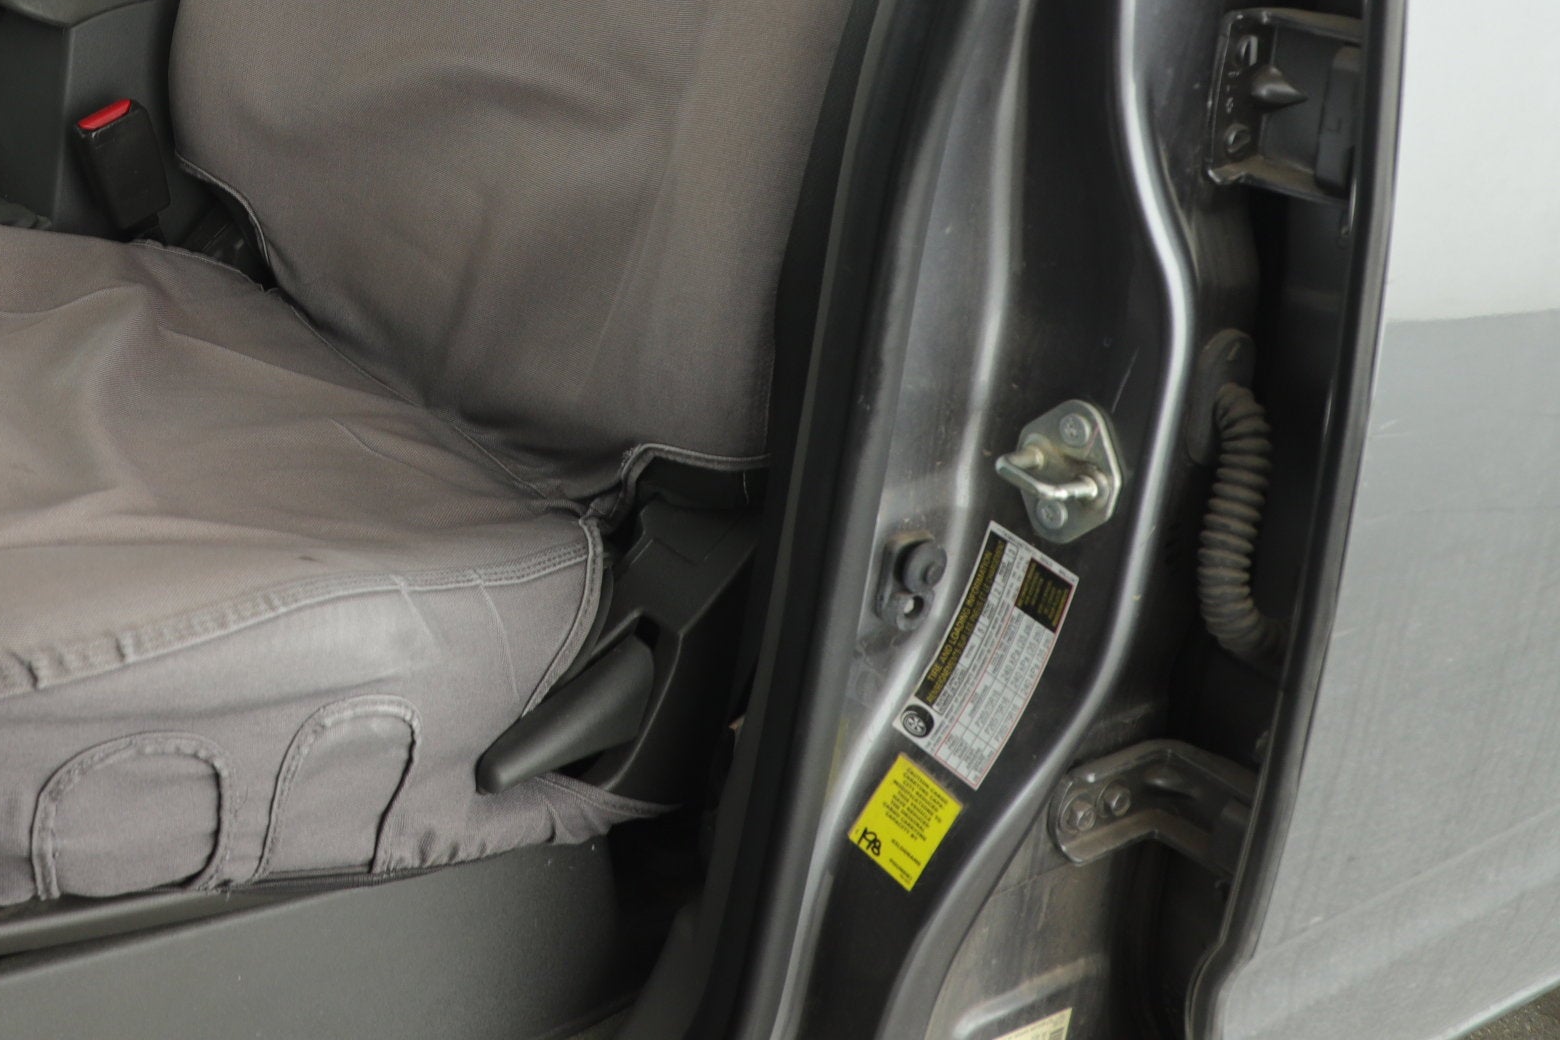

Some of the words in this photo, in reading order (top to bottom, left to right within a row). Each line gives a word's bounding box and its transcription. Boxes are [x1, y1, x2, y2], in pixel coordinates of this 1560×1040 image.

[927, 661, 942, 683] TIRE
[938, 642, 953, 663] AND
[947, 605, 970, 645] LOADING
